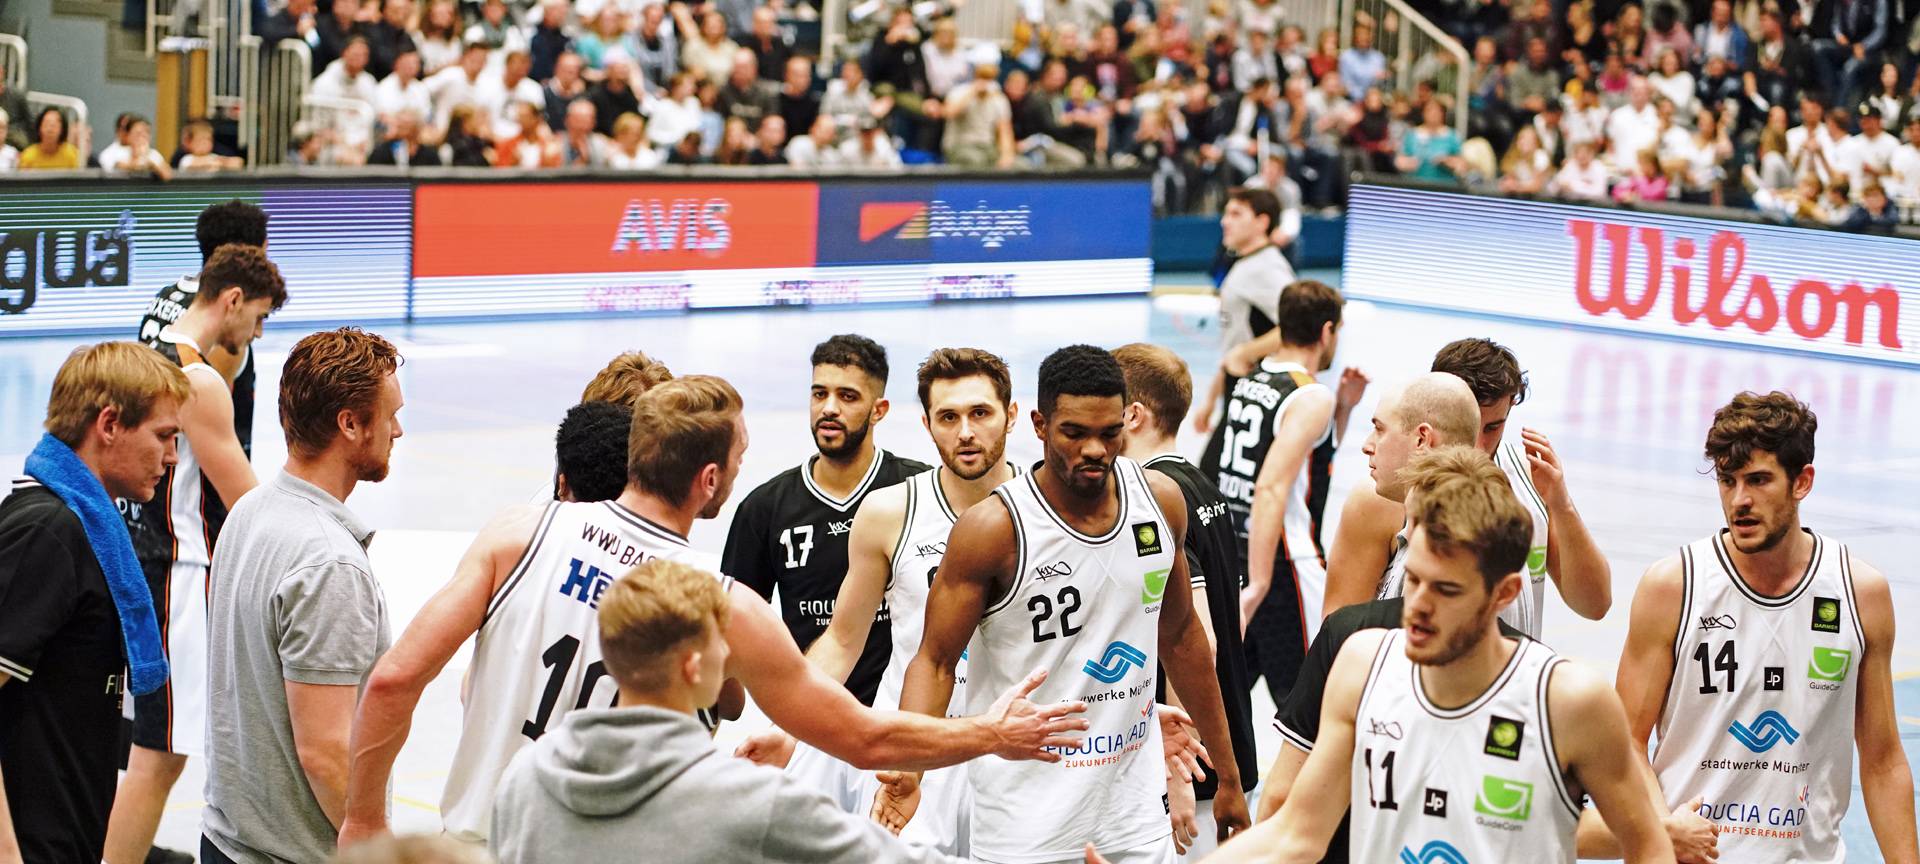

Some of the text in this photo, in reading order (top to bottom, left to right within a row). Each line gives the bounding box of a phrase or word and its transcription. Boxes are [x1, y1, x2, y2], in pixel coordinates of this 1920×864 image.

[611, 198, 733, 252] AVIS
[1566, 219, 1903, 351] Wilson
[779, 524, 814, 569] 17
[1027, 585, 1082, 643] 22
[1693, 640, 1738, 694] 14
[1365, 748, 1398, 811] 11
[1768, 807, 1806, 827] GAD
